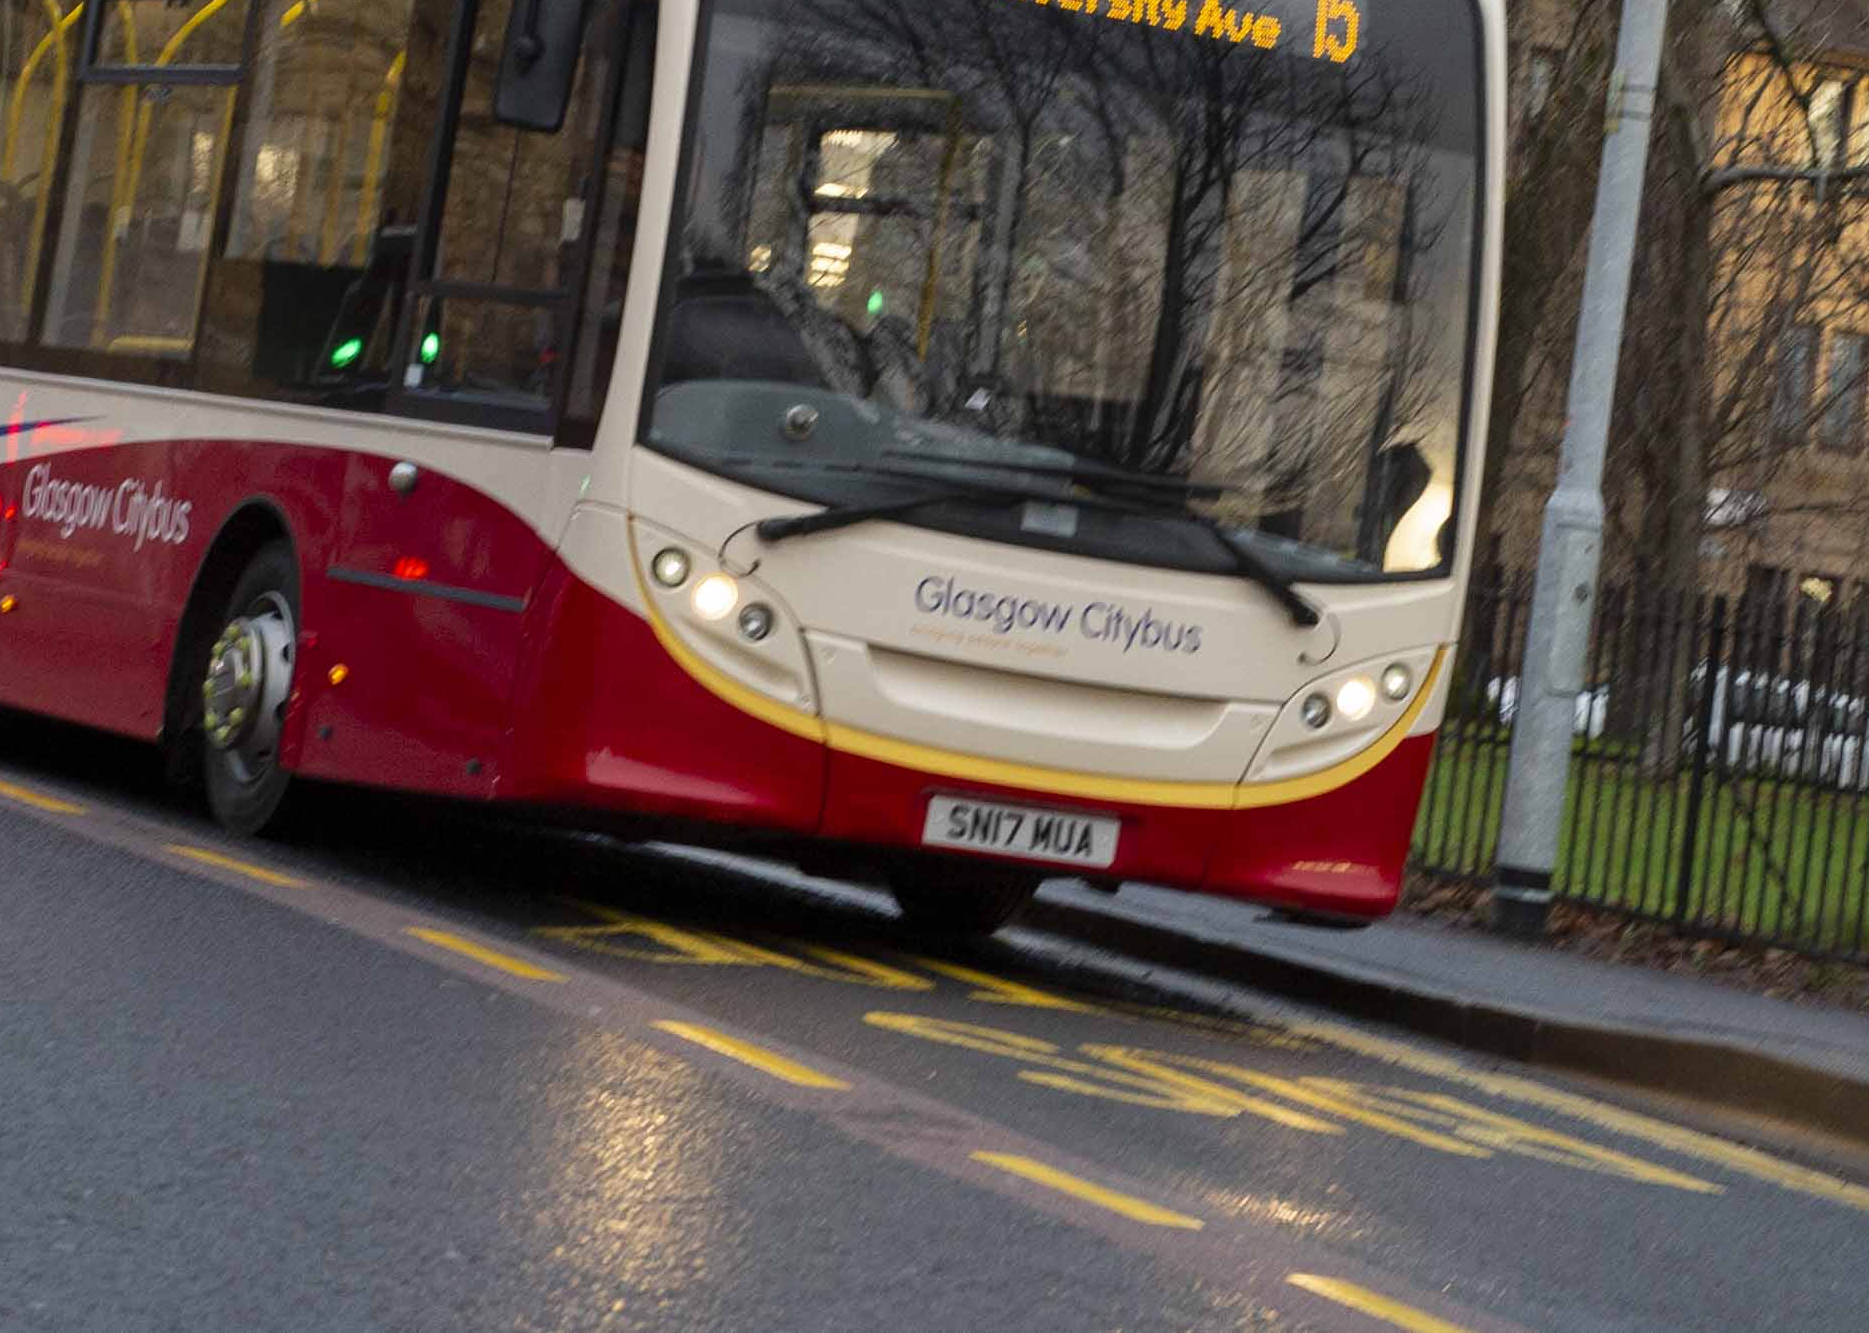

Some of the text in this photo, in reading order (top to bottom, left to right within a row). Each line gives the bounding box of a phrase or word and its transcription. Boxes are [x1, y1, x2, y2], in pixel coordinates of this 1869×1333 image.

[24, 463, 112, 539] Glasgow
[115, 478, 192, 553] Citybus
[915, 575, 1073, 634] Glasgow
[1079, 601, 1203, 654] Citybus
[948, 804, 1093, 858] SN17 MUA
